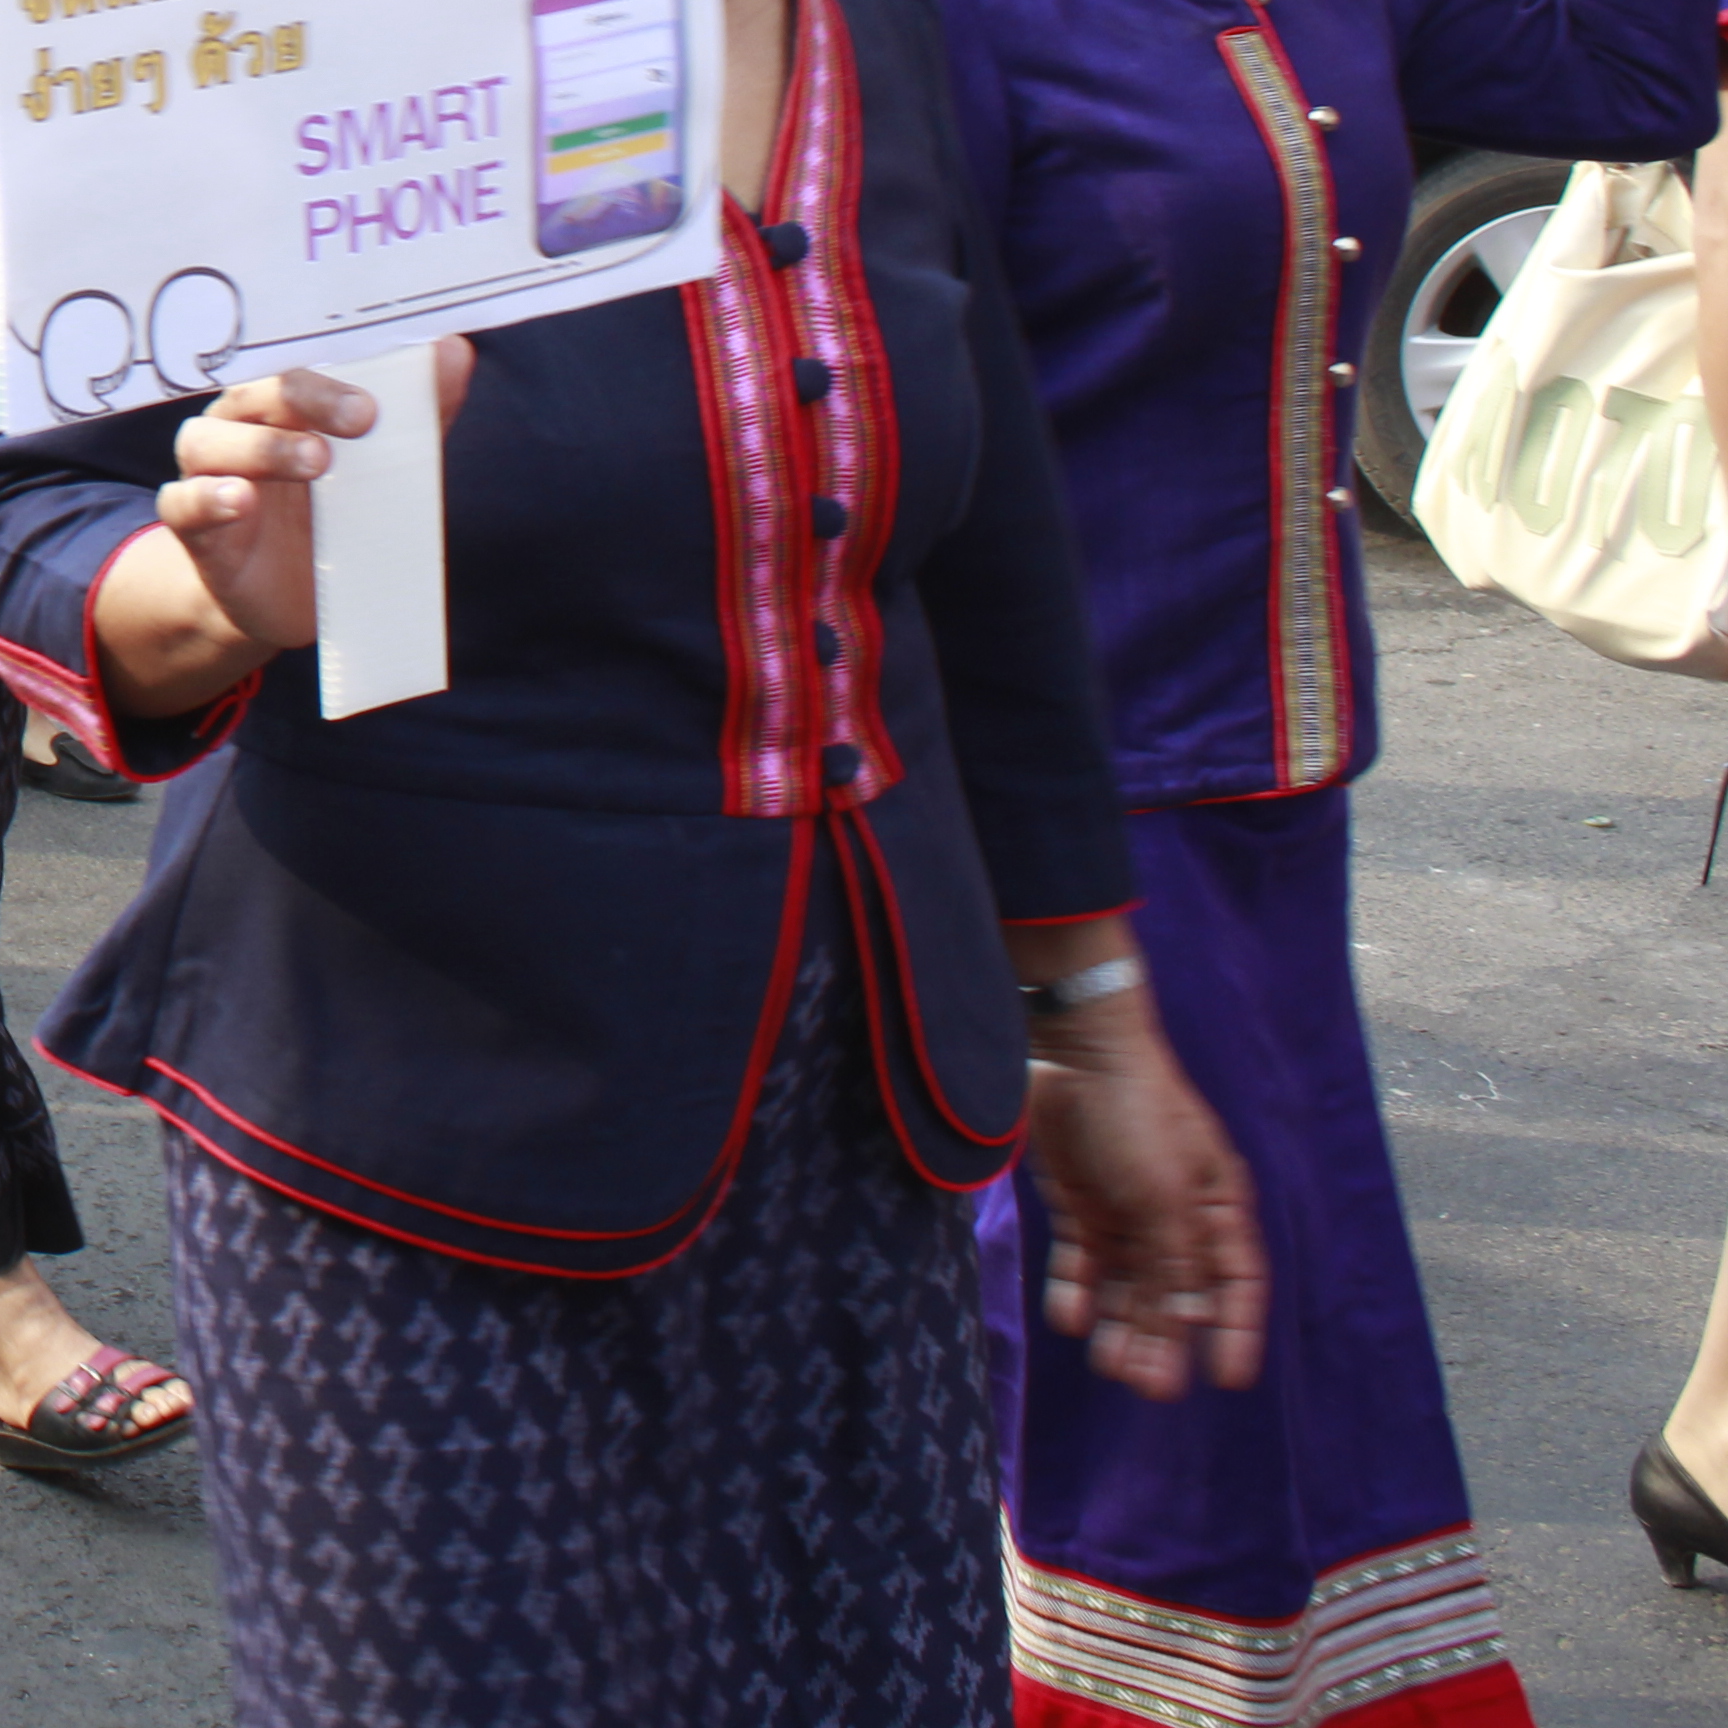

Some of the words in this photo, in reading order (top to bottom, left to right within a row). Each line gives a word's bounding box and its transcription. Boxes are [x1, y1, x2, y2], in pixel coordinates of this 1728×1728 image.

[17, 46, 168, 123] ง่ายๆ
[189, 10, 310, 90] ด้วย
[294, 75, 511, 178] SMART
[303, 159, 507, 263] PHONE
